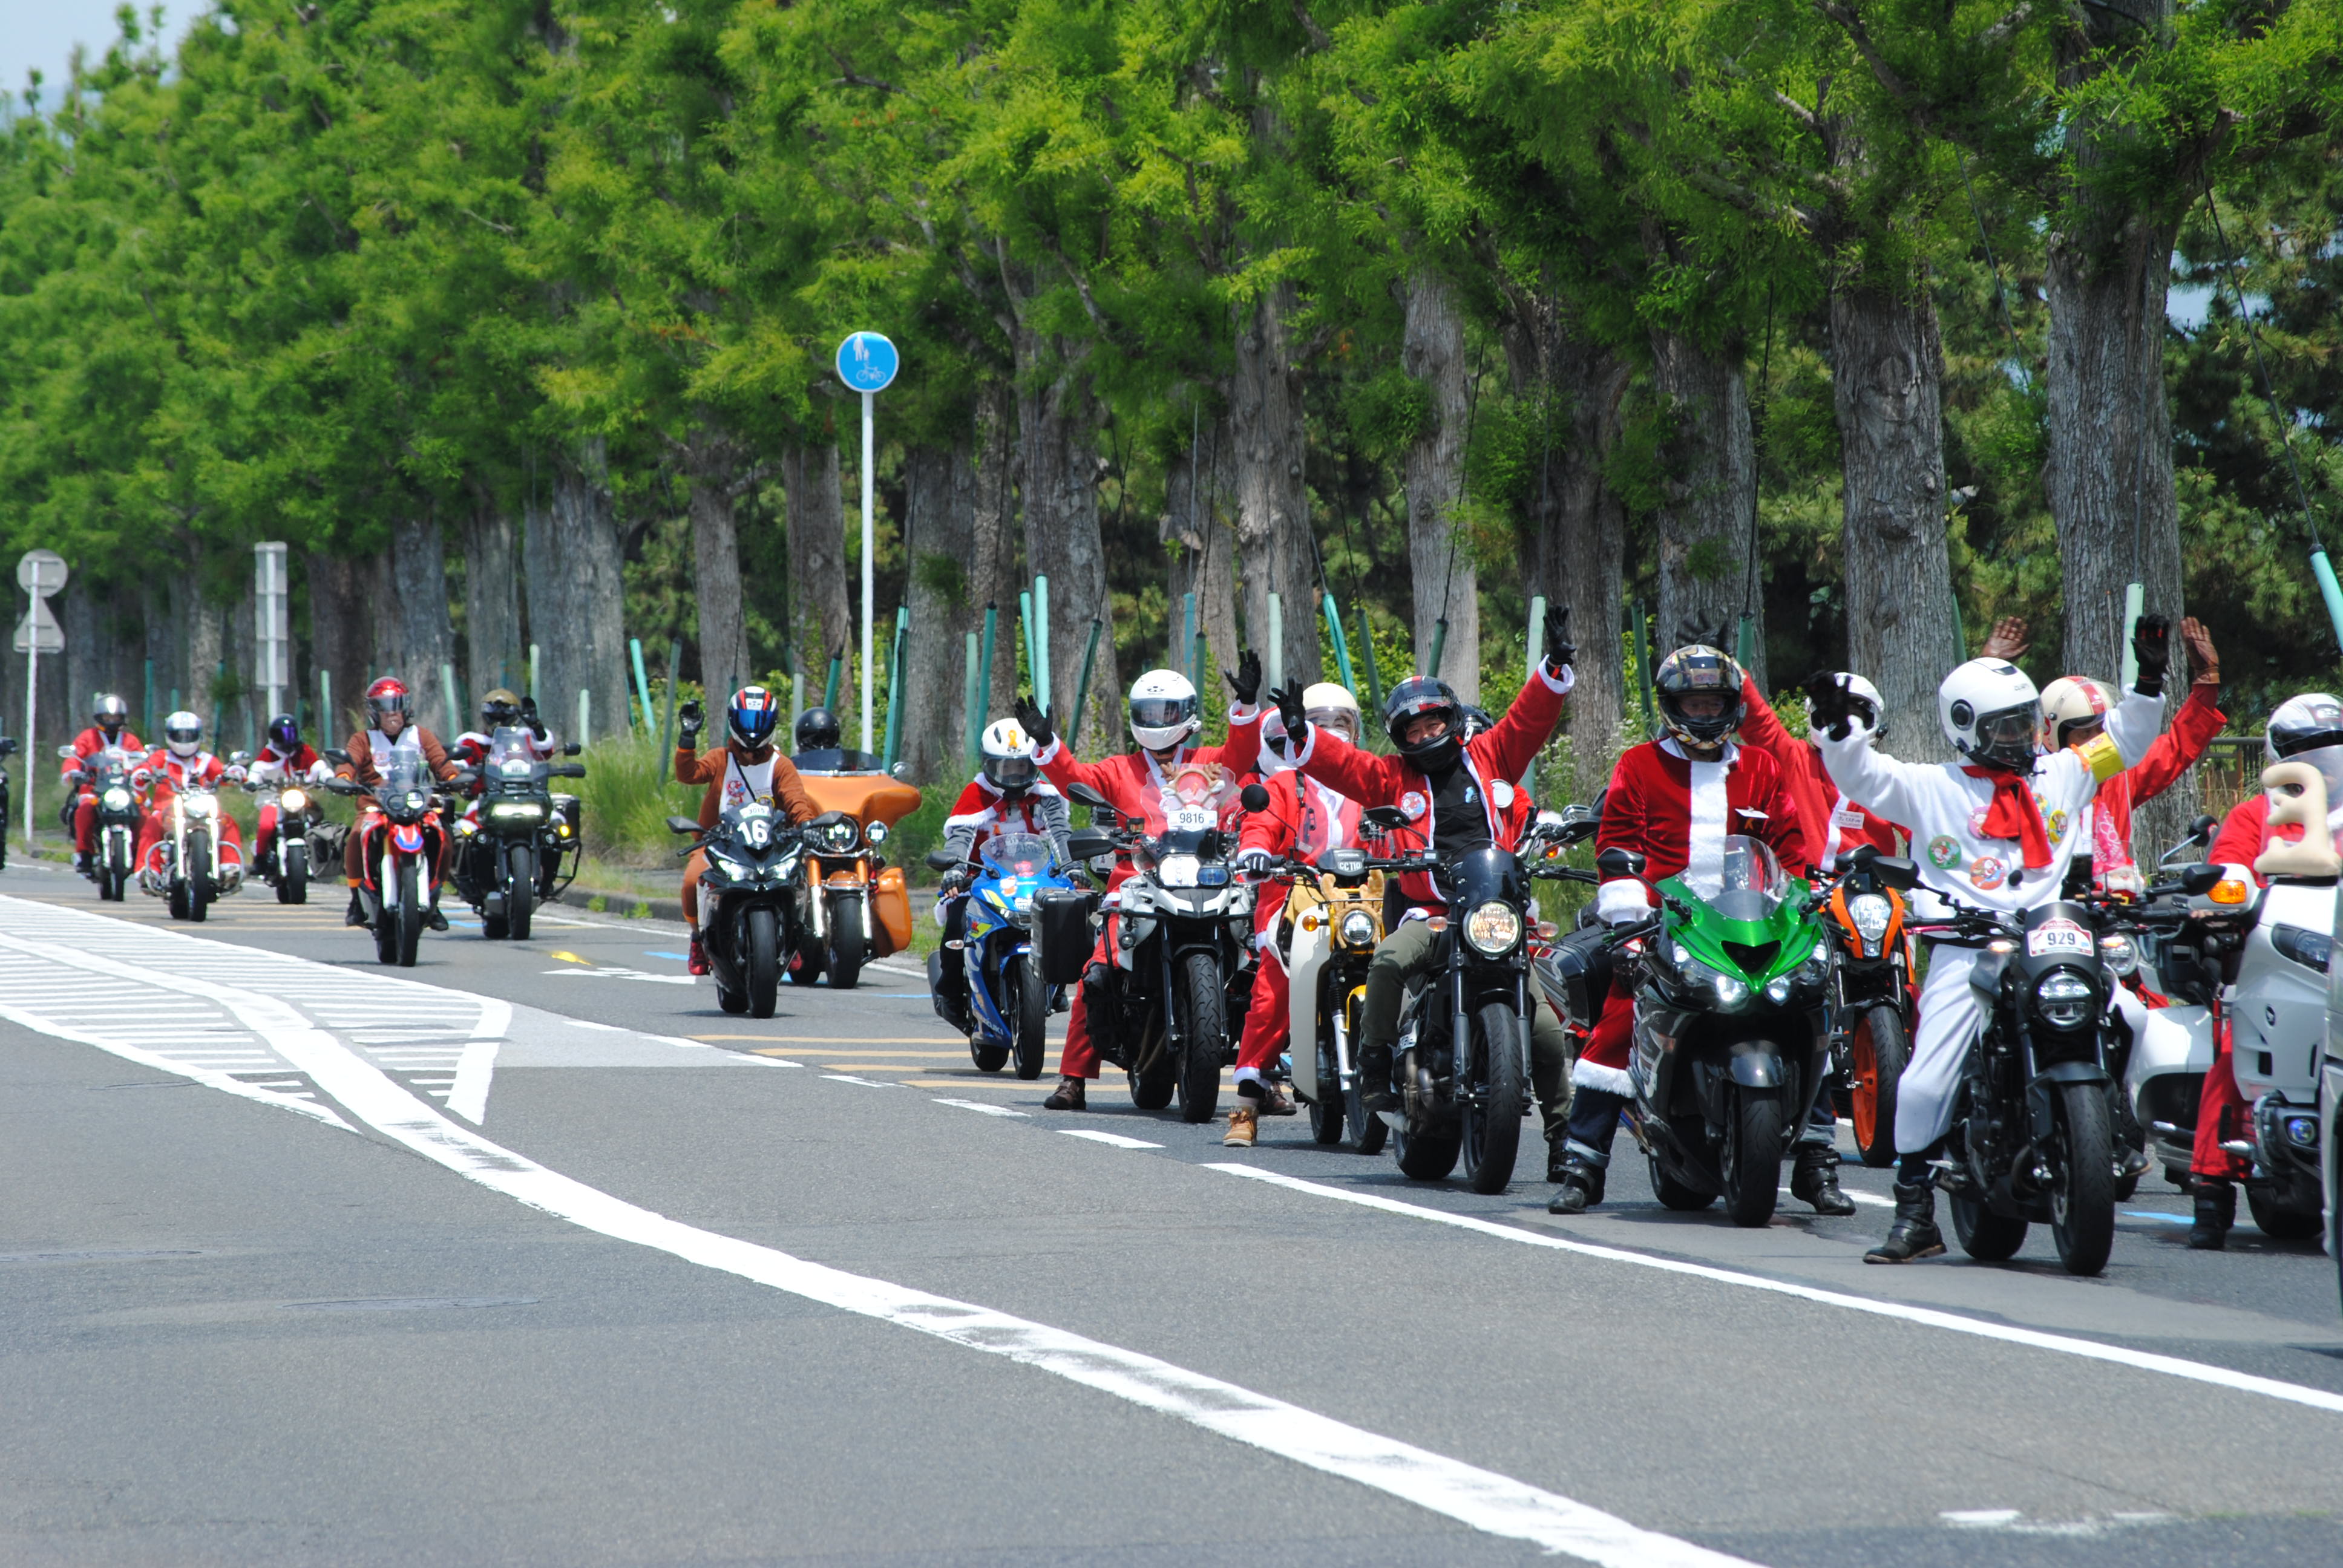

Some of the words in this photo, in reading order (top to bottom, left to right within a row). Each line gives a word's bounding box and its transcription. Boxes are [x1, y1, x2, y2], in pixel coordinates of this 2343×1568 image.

[1179, 812, 1205, 824] 9816
[737, 819, 768, 845] 16
[2047, 932, 2076, 946] 929
